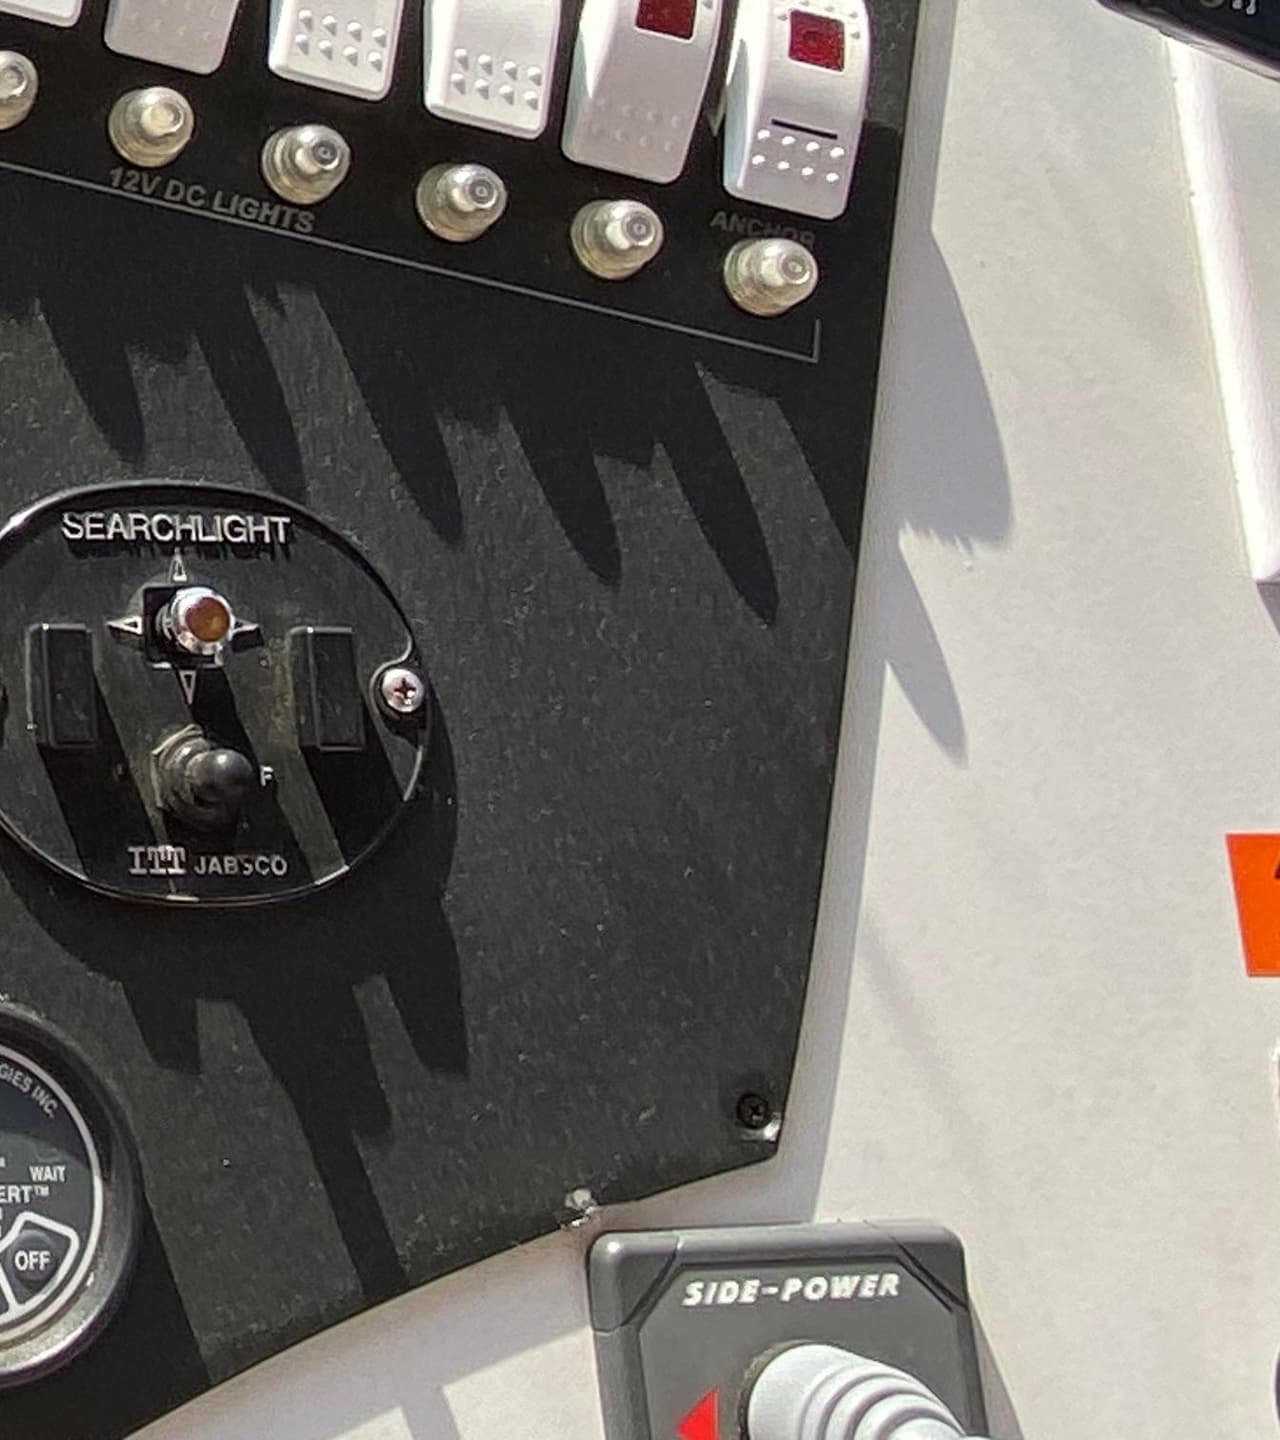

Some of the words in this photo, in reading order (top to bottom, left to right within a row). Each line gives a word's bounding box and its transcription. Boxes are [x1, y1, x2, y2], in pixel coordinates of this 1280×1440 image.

[109, 167, 162, 193] 12V
[164, 179, 205, 207] DC
[212, 190, 316, 233] LIGHTS
[62, 511, 291, 543] SEARCHLIGHT
[127, 846, 186, 876] ITT
[193, 856, 287, 878] JABSCO
[29, 1166, 66, 1182] WAIT
[14, 1251, 50, 1270] OFF
[682, 1273, 900, 1306] SIDE-POWER
